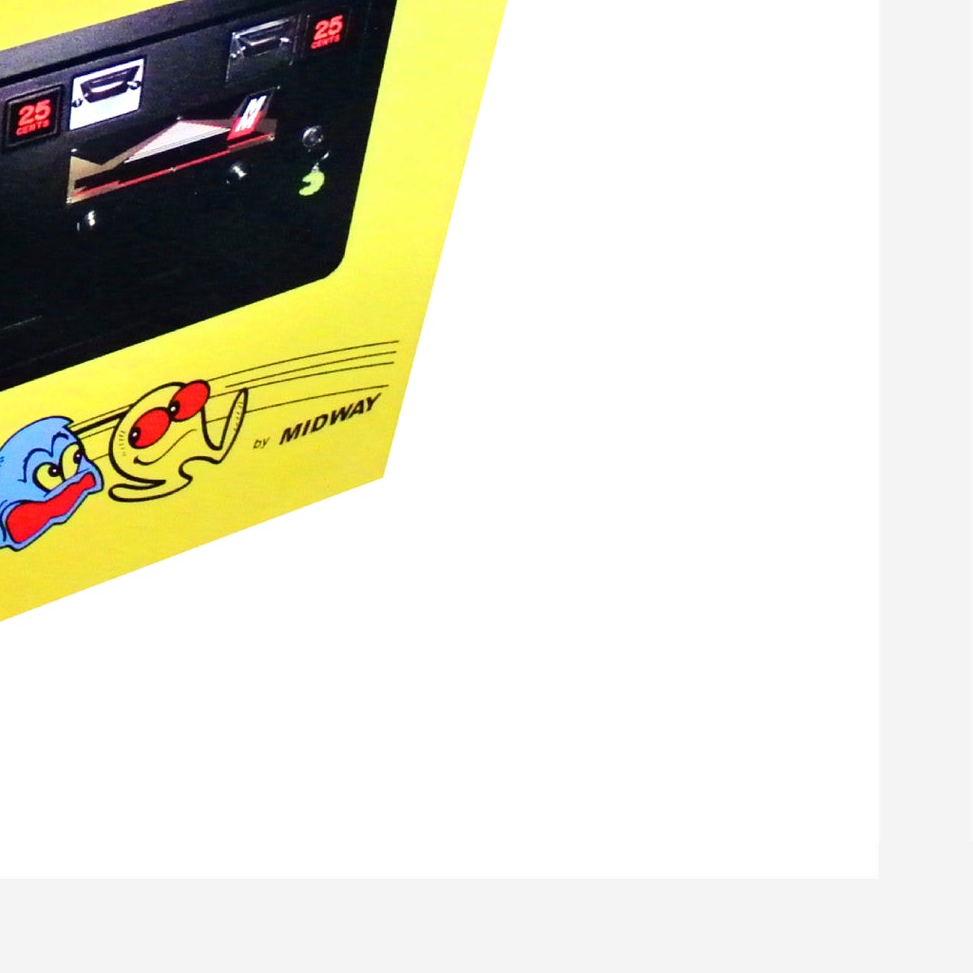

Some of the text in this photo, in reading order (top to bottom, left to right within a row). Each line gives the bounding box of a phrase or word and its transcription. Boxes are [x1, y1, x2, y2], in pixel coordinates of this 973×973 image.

[314, 15, 343, 40] 25
[311, 35, 340, 49] CENTS
[18, 99, 52, 126] 25
[16, 119, 49, 136] CENTS
[253, 392, 382, 449] by MIDWAY
